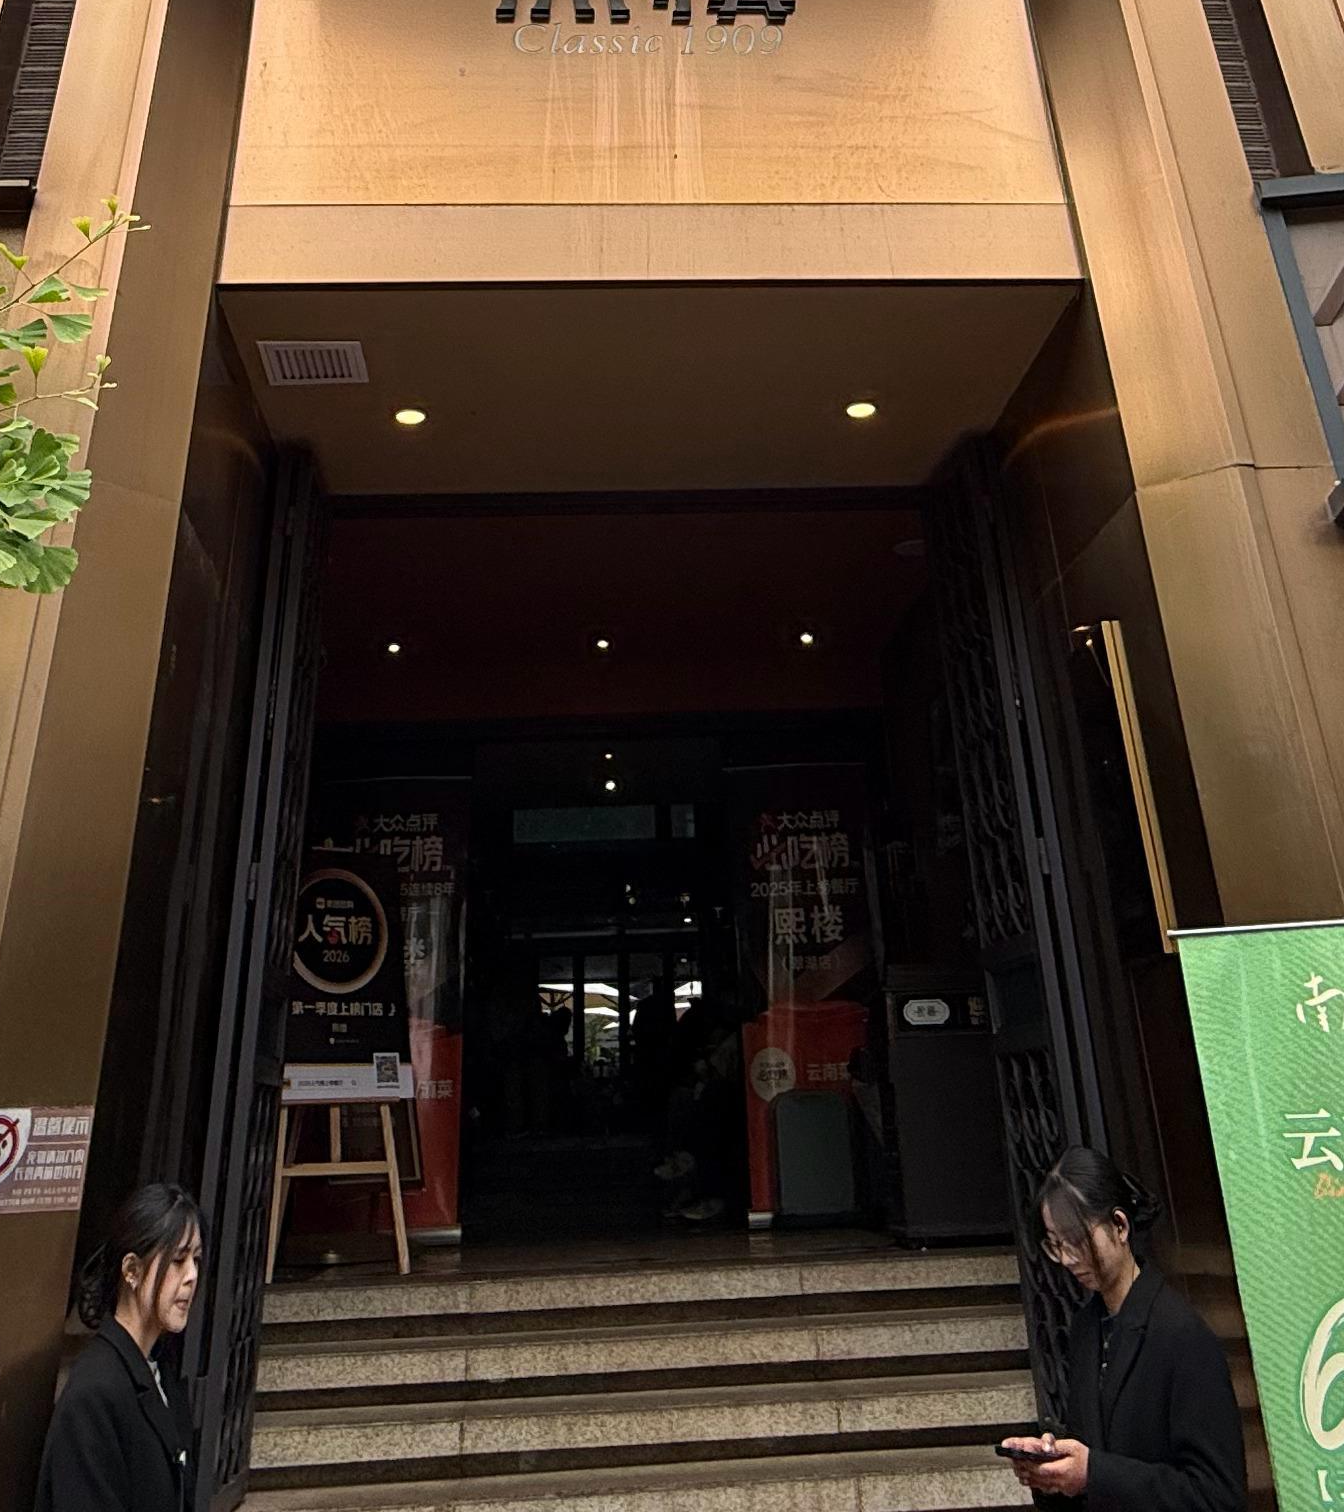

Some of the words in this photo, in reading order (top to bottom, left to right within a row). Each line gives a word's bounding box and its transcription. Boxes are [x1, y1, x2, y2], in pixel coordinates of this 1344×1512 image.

[513, 23, 663, 55] Classic
[681, 24, 784, 56] 1909
[373, 813, 440, 832] 大众点评
[776, 810, 840, 829] 大众点评
[298, 914, 373, 946] 人气榜
[322, 950, 351, 964] 2026
